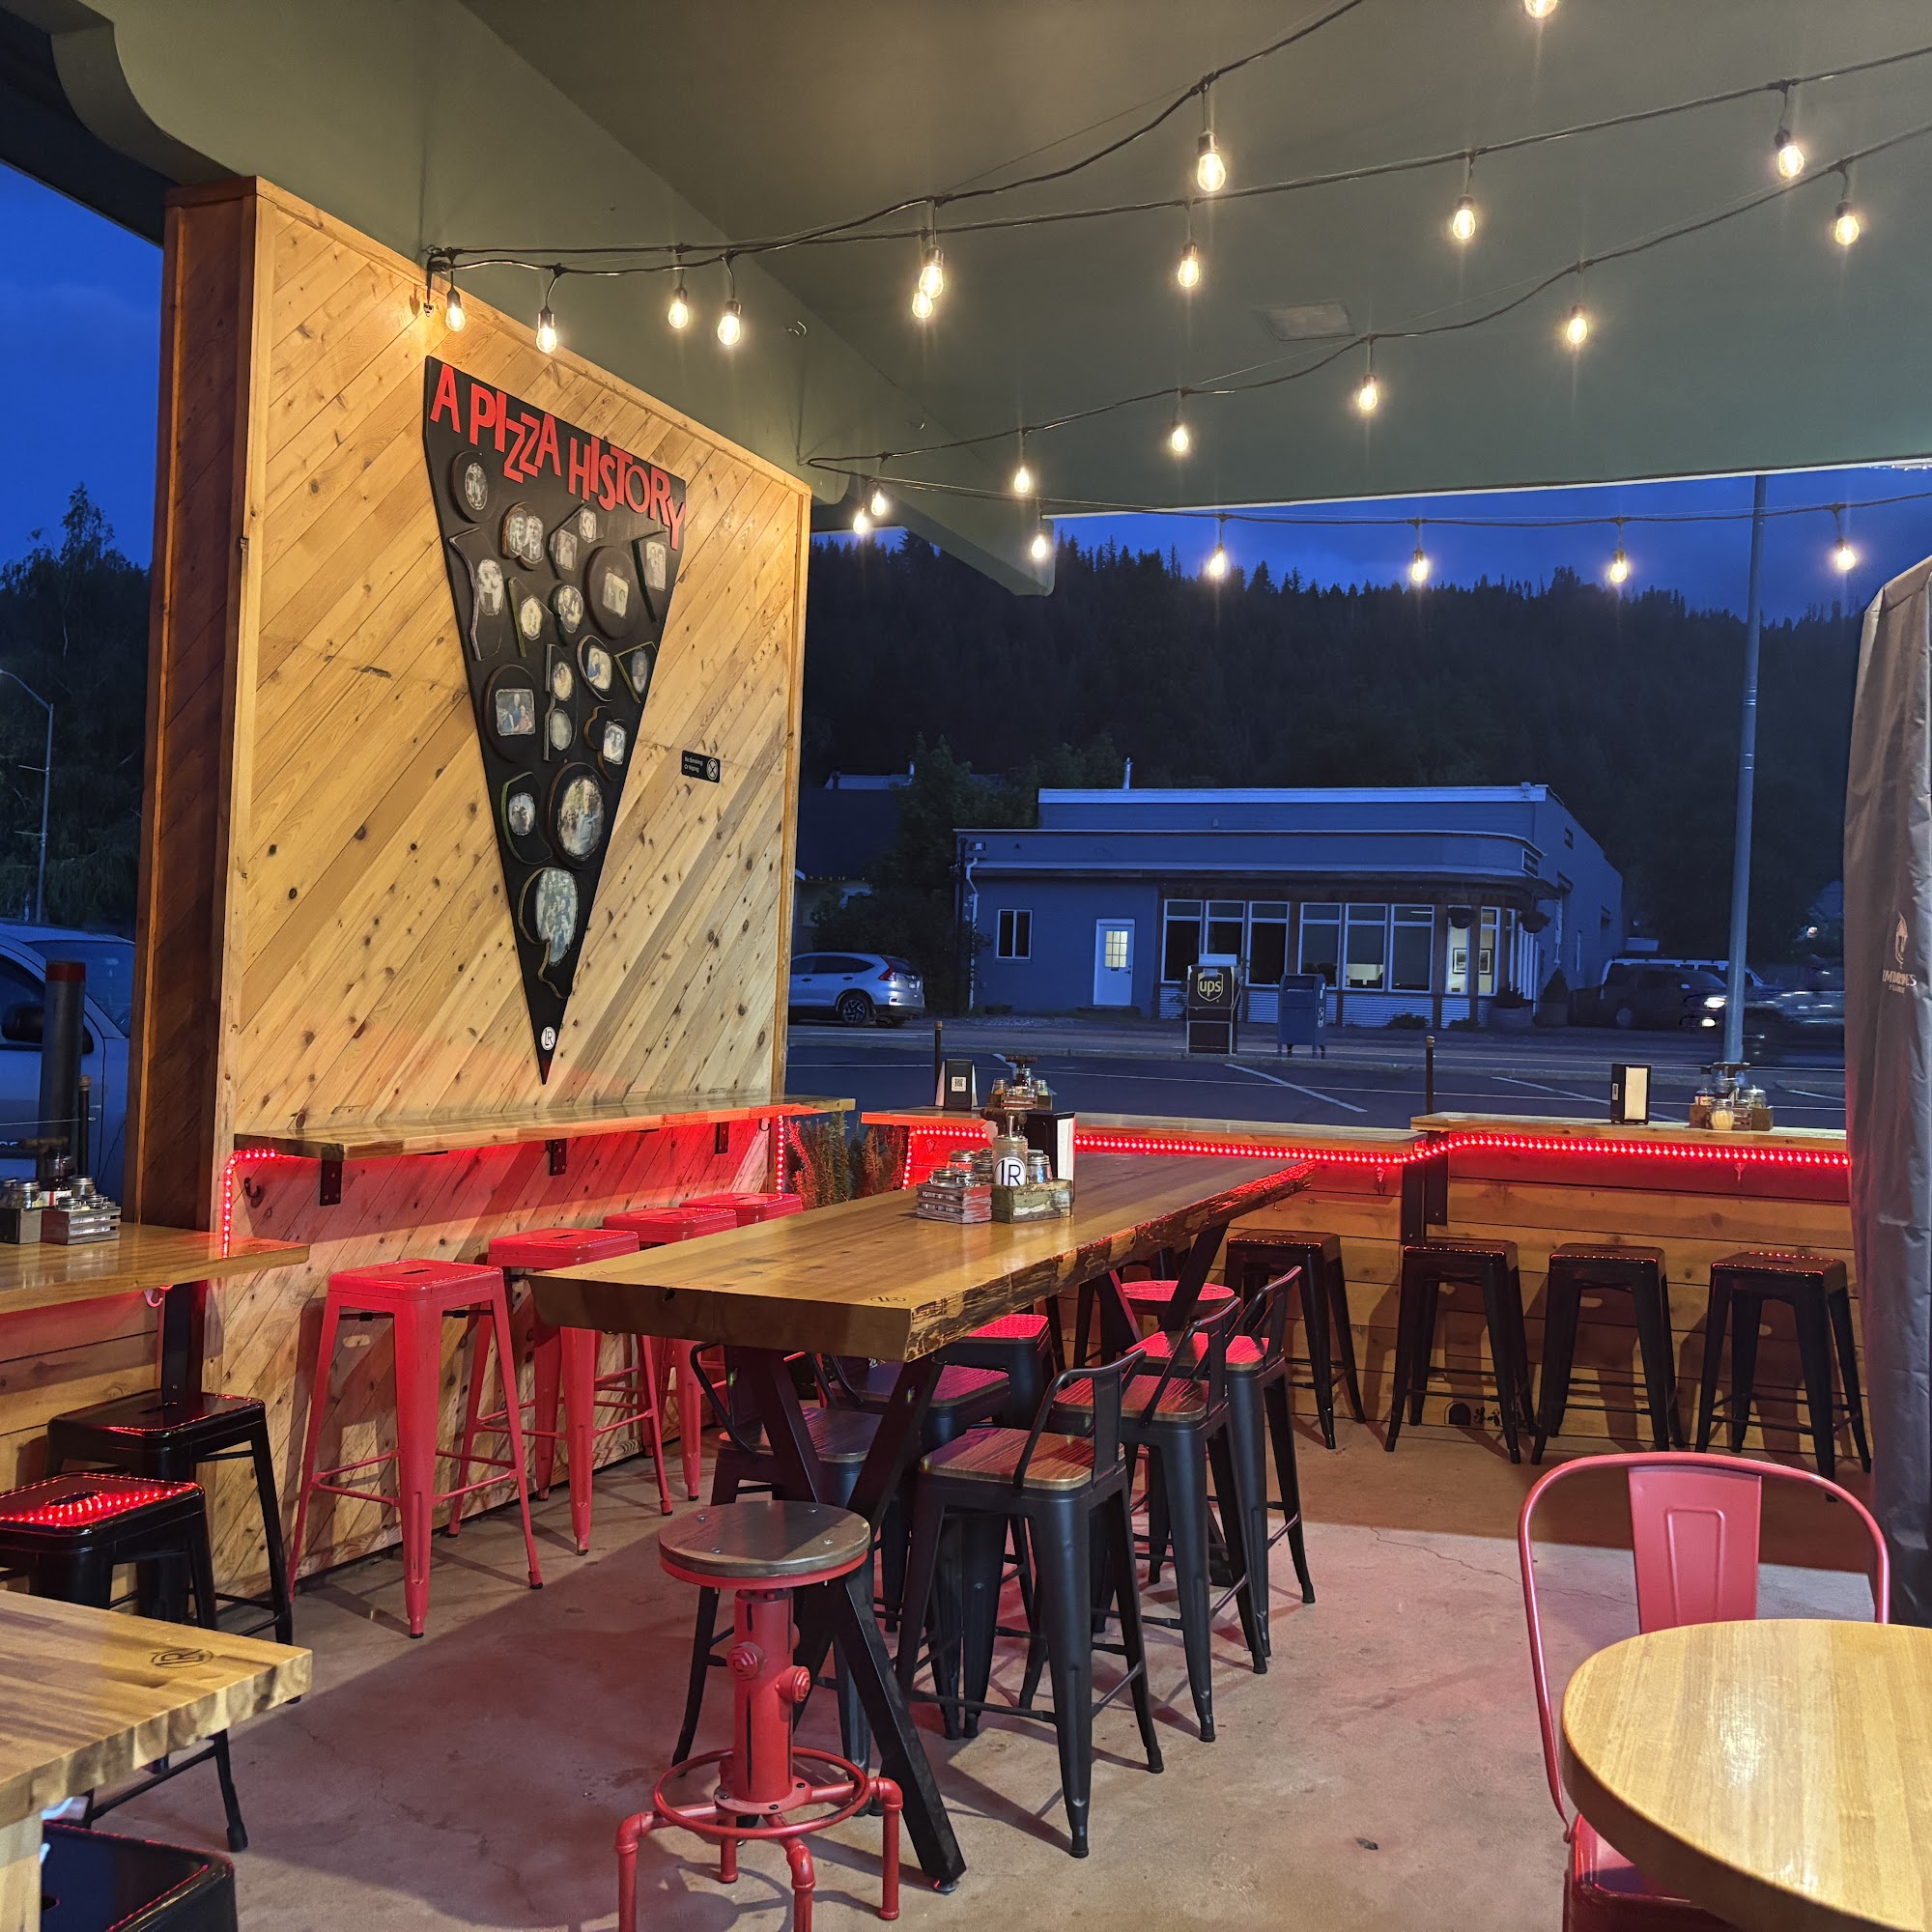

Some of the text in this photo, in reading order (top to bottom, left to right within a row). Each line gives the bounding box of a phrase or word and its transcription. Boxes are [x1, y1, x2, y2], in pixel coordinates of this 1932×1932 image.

[430, 363, 686, 551] A PIZZA HISTORY
[1200, 980, 1222, 997] ups
